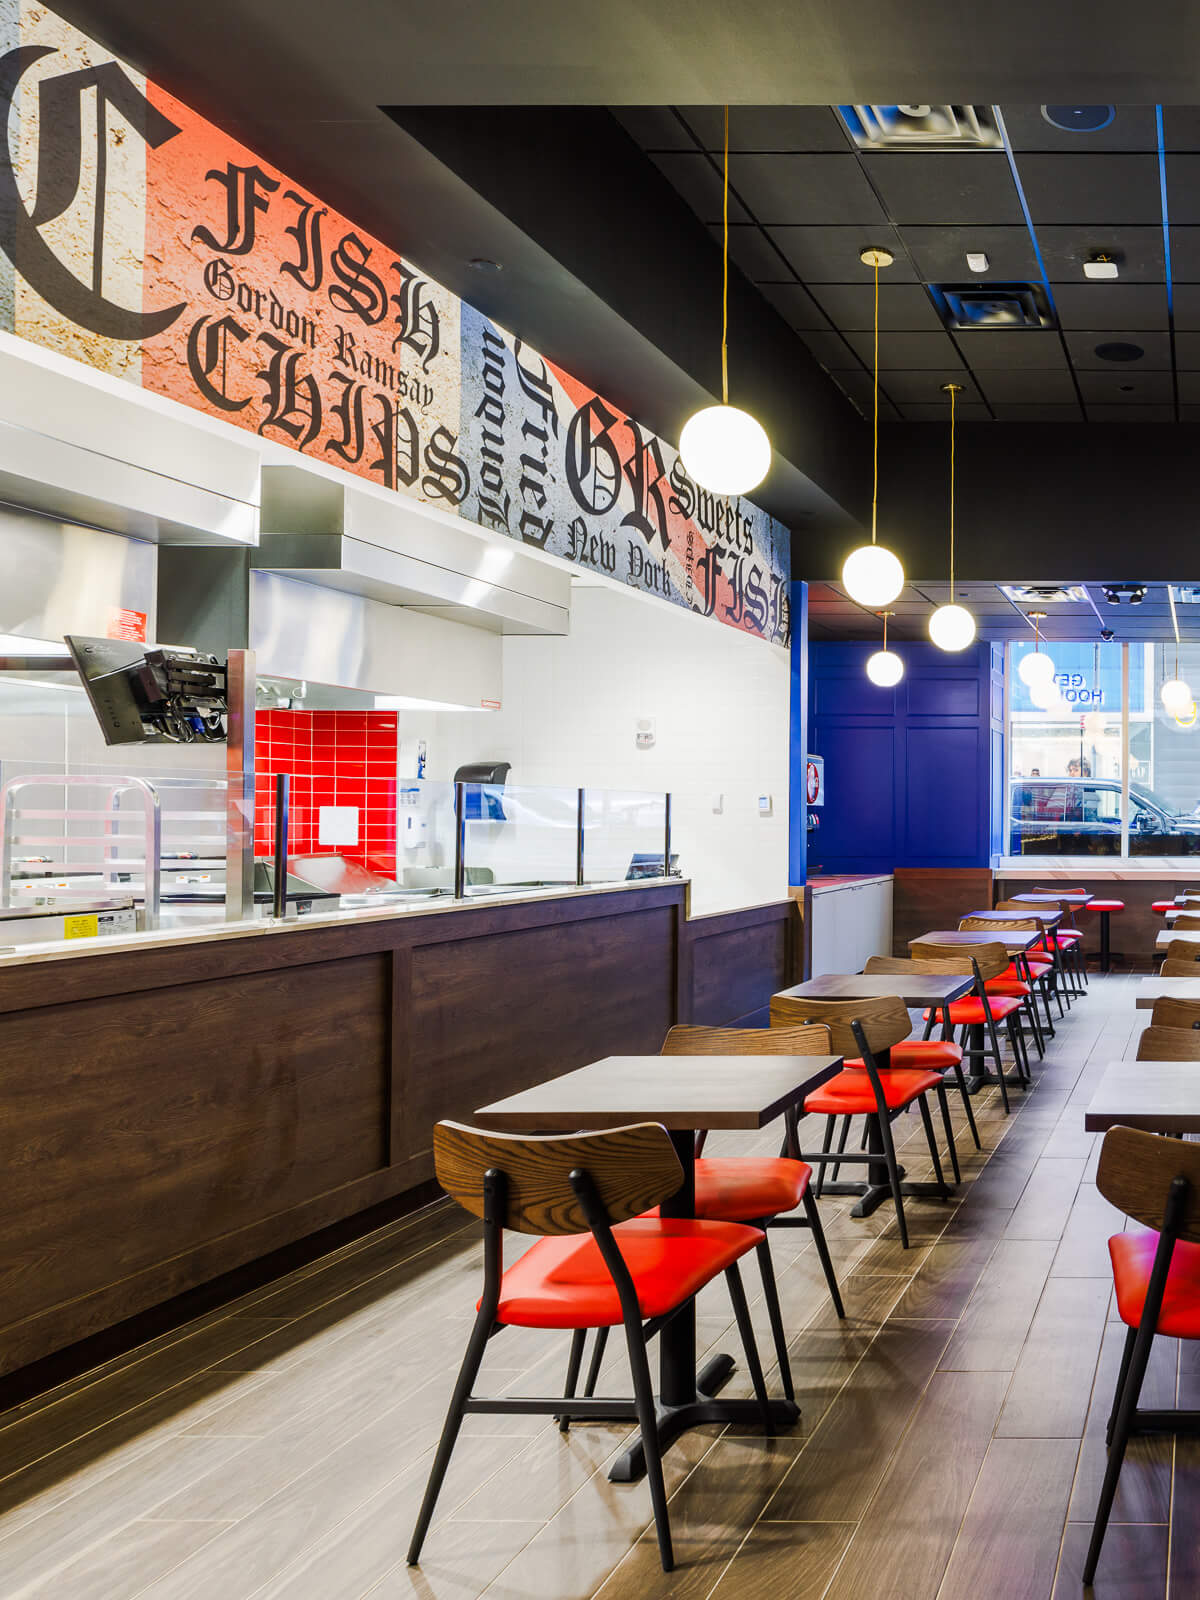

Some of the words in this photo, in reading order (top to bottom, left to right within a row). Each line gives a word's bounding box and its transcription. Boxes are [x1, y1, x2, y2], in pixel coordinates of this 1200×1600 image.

[191, 161, 440, 374] FISH
[204, 258, 317, 348] Gordon
[333, 325, 434, 415] Ramsay
[187, 314, 470, 506] CHIPS
[475, 326, 510, 534] London
[514, 337, 558, 551] Fried
[669, 455, 753, 556] Sweets
[564, 516, 616, 572] New
[626, 539, 671, 596] York
